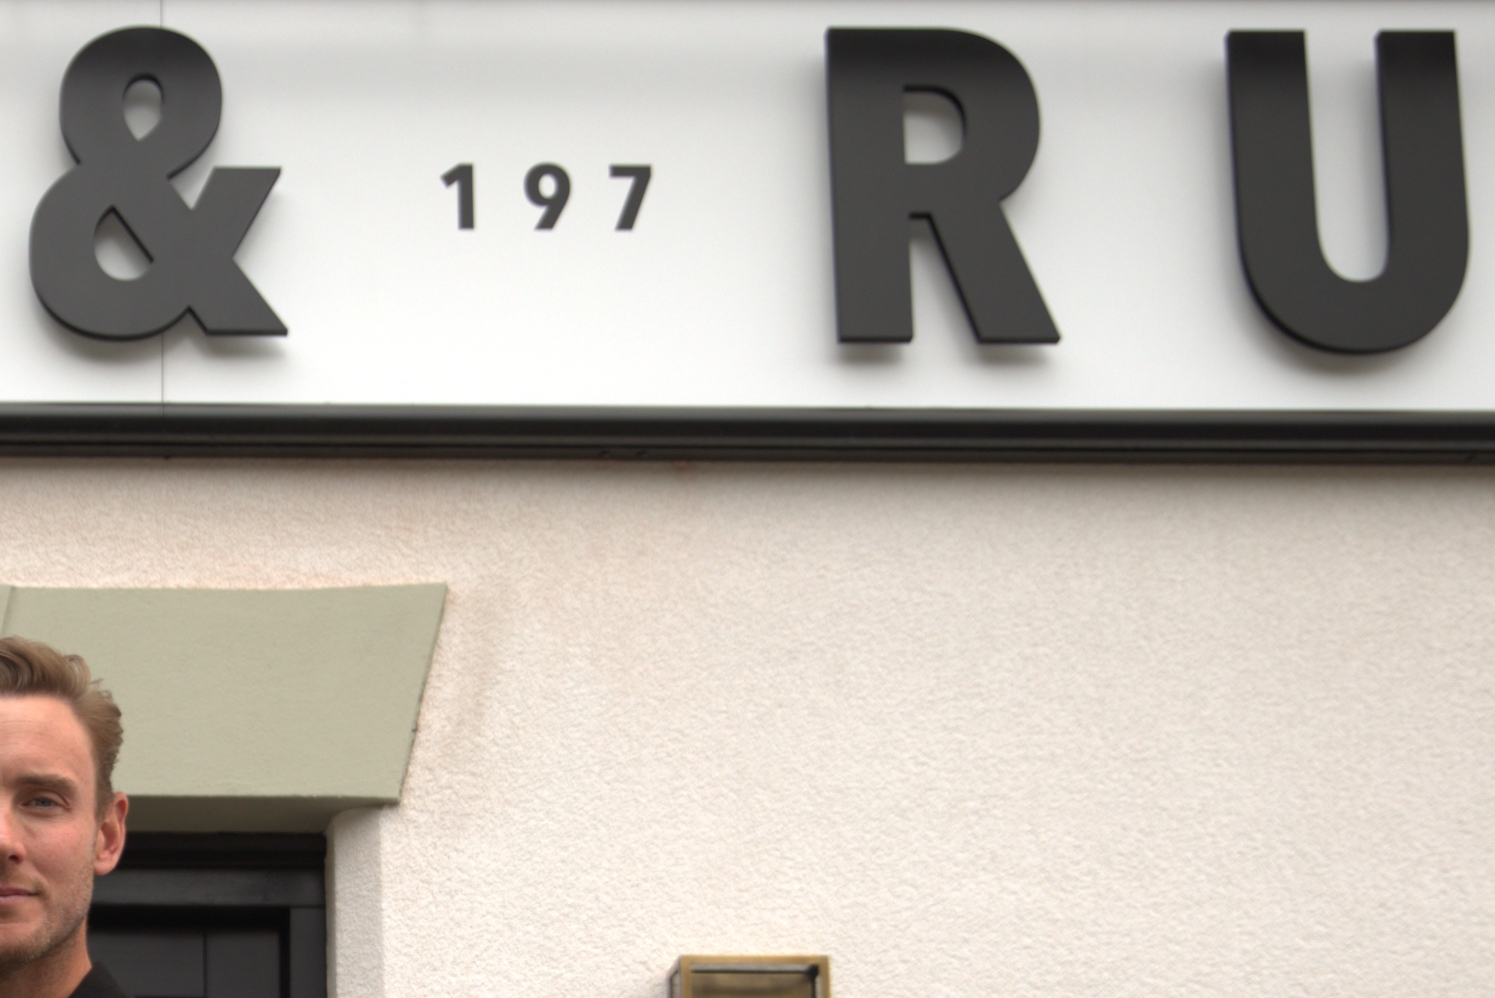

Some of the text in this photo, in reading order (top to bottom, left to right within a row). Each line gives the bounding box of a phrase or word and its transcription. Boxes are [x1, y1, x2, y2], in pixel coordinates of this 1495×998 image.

[29, 26, 289, 342] &
[825, 26, 1471, 356] RU
[441, 162, 653, 231] 197
